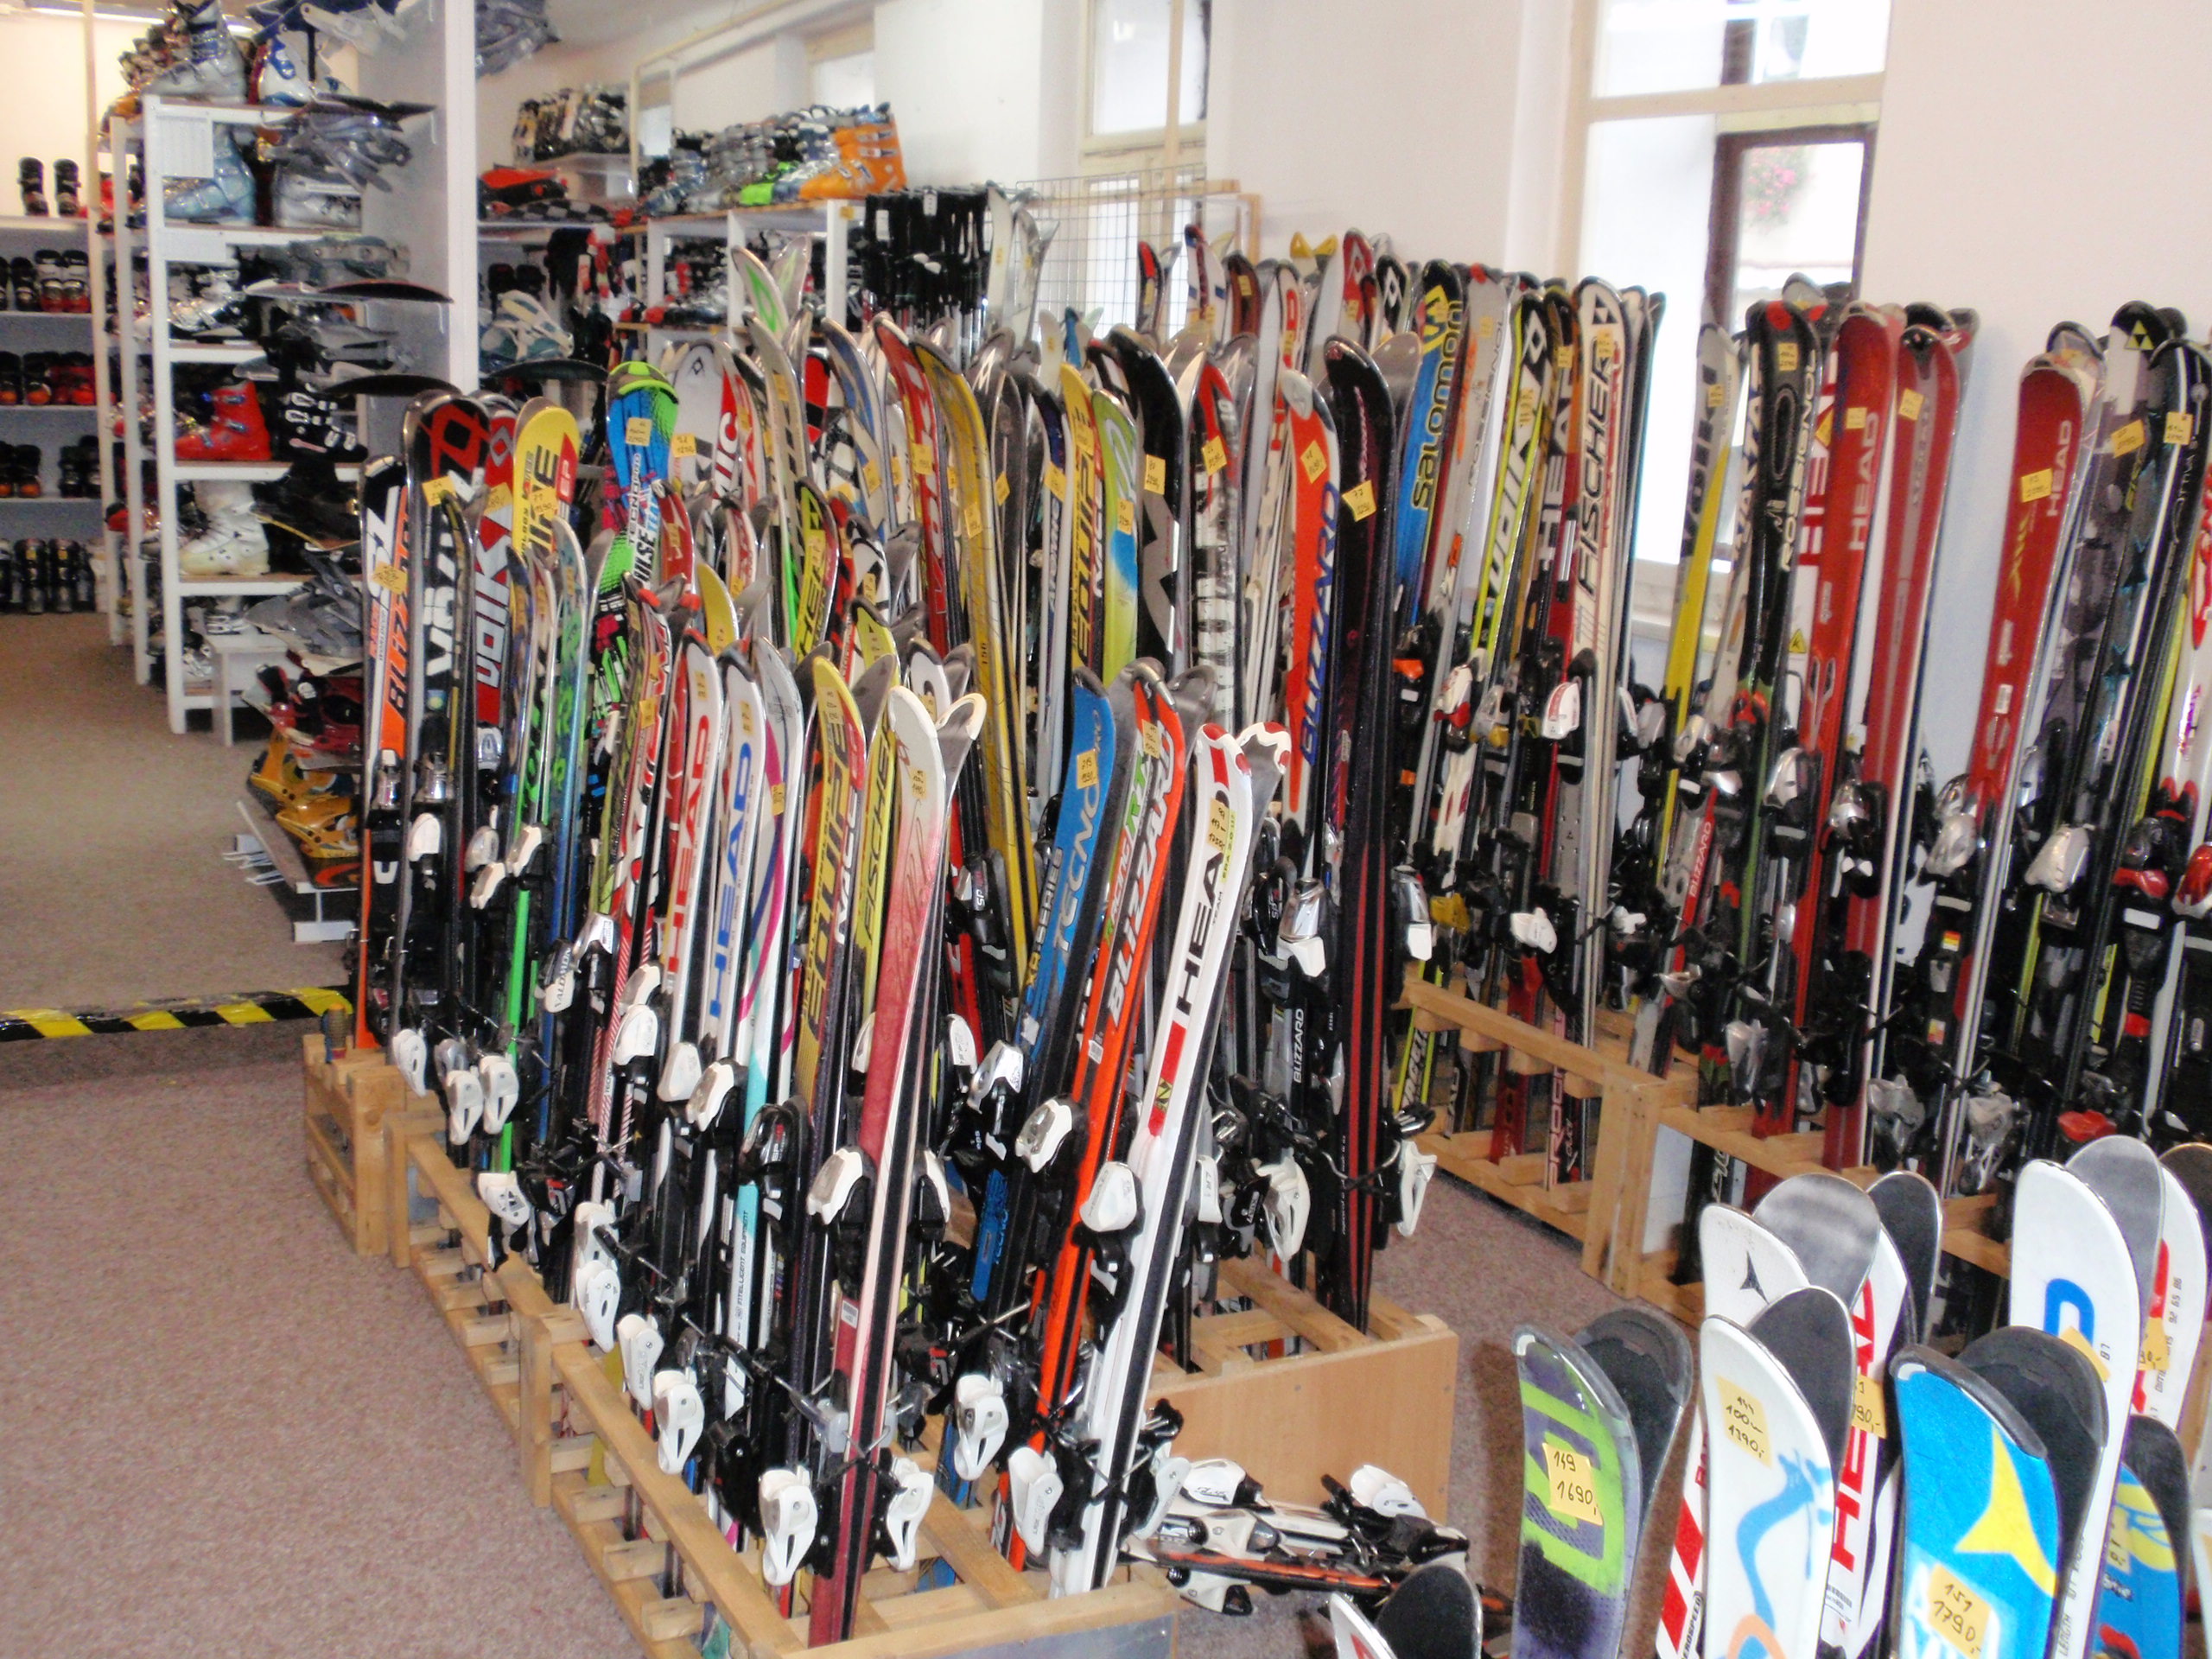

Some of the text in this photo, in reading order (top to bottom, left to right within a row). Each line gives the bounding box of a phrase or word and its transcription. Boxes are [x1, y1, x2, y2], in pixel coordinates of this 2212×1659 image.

[1780, 349, 1816, 571] ROSSIGNOL
[1848, 412, 1879, 550] HEAD
[2046, 419, 2072, 517] HEAD
[668, 715, 710, 973] HEAD
[709, 741, 752, 1020] HEAD
[1035, 848, 1064, 946] SERIES
[1053, 782, 1101, 951] TECNO
[1107, 719, 1175, 1027] BLIZZARD
[1689, 821, 1712, 898] BLIZZARD
[1293, 1007, 1305, 1084] BLIZZARD
[737, 1210, 750, 1306] INTELLIGENT EQUIPMENT
